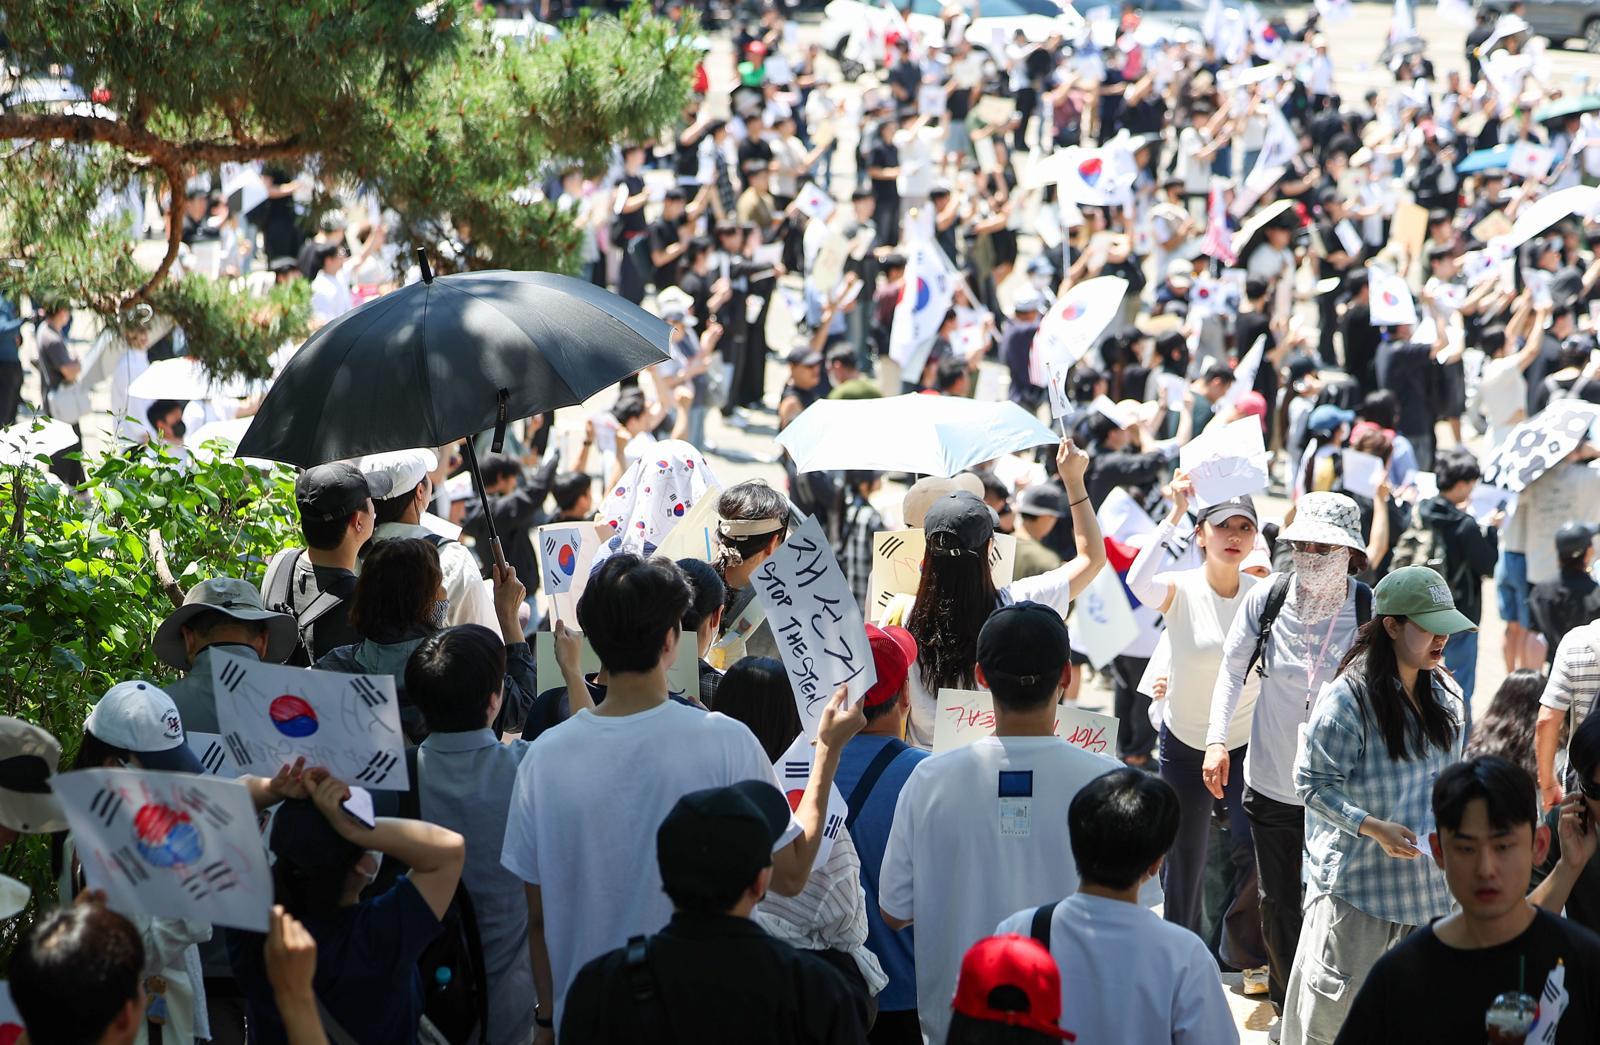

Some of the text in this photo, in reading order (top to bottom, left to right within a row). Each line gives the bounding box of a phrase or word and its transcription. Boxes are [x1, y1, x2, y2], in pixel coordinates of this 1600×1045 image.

[757, 561, 793, 607] STOP
[778, 616, 808, 658] THE
[787, 537, 865, 687] 재선거
